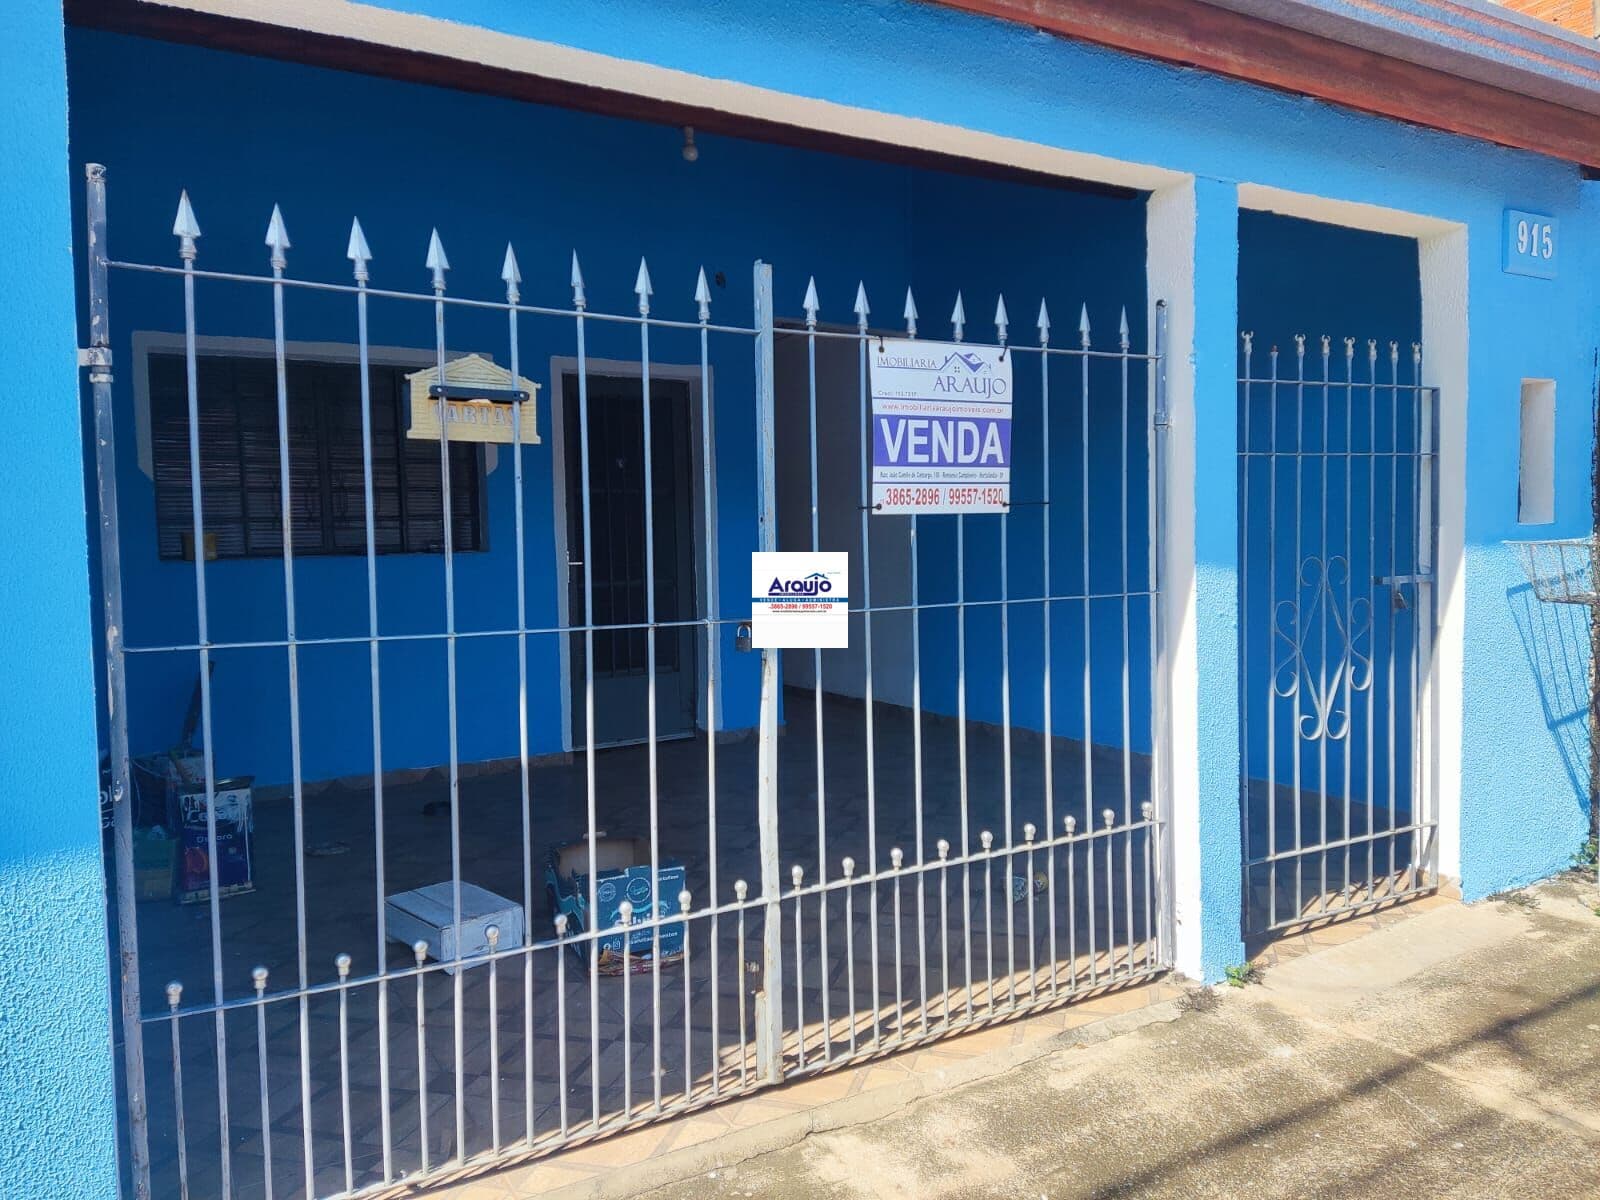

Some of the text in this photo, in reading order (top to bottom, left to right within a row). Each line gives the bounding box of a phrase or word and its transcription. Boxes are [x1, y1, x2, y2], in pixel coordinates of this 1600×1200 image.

[1517, 220, 1553, 259] 915
[877, 355, 937, 369] IMOBILIARIA
[933, 376, 1007, 399] ARAUJO
[880, 418, 1004, 464] VENDA
[886, 488, 940, 506] 3865-2896
[949, 487, 1004, 505] 99557-1520
